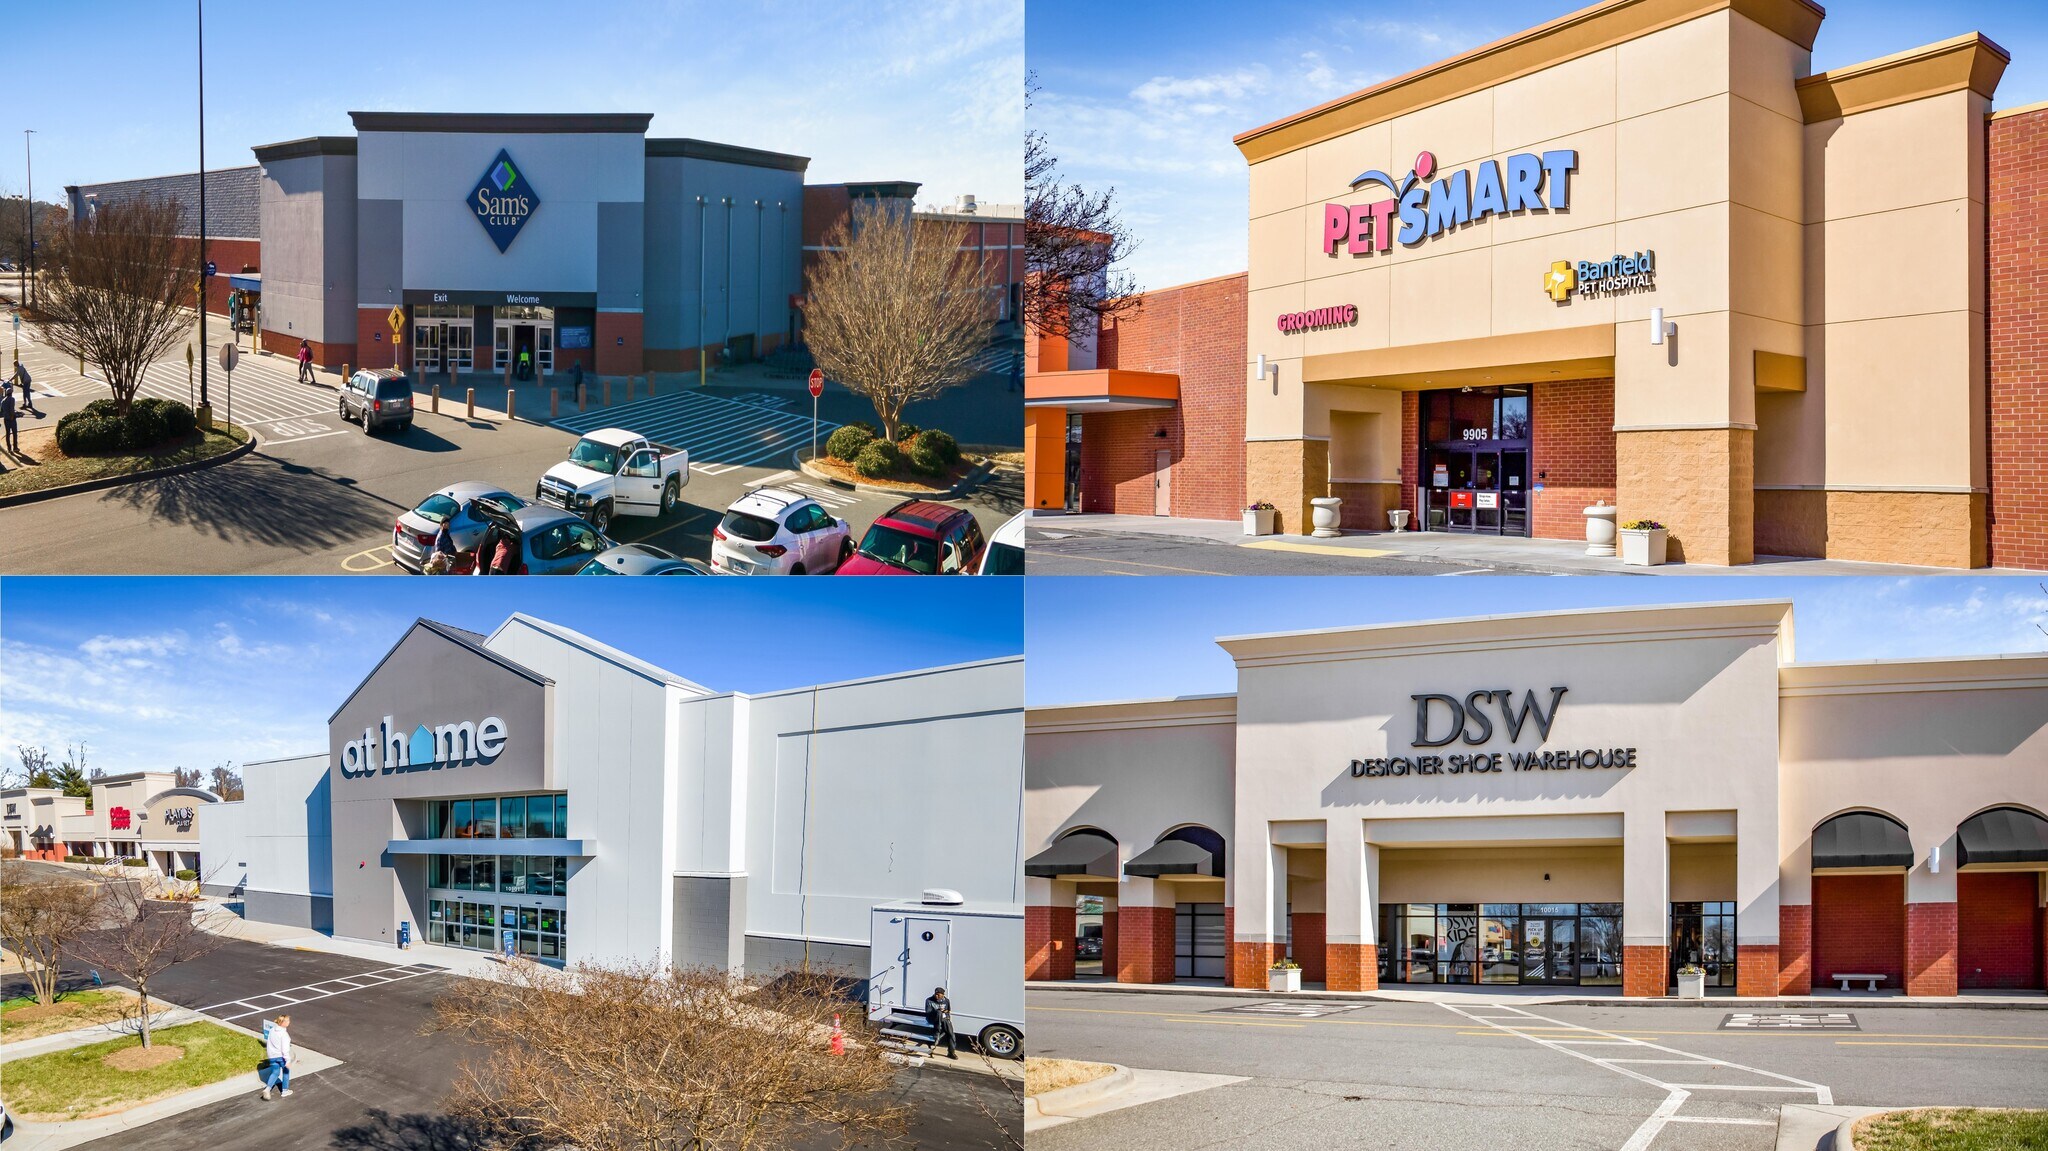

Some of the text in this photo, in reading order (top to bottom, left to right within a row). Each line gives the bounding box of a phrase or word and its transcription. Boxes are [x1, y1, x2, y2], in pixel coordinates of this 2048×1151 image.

[478, 188, 528, 216] Sam's
[490, 217, 517, 226] CLUB
[1578, 249, 1653, 282] Banfield
[434, 293, 540, 304] Exit Welcome
[1579, 274, 1651, 295] PET HOSPITAL
[1277, 303, 1355, 332] GROOMING
[810, 377, 823, 389] STOP
[1463, 428, 1488, 441] 9905
[1410, 687, 1569, 747] DSW
[342, 727, 378, 773] at
[1351, 747, 1637, 778] DESIGNER SHOE WAREHOUSE
